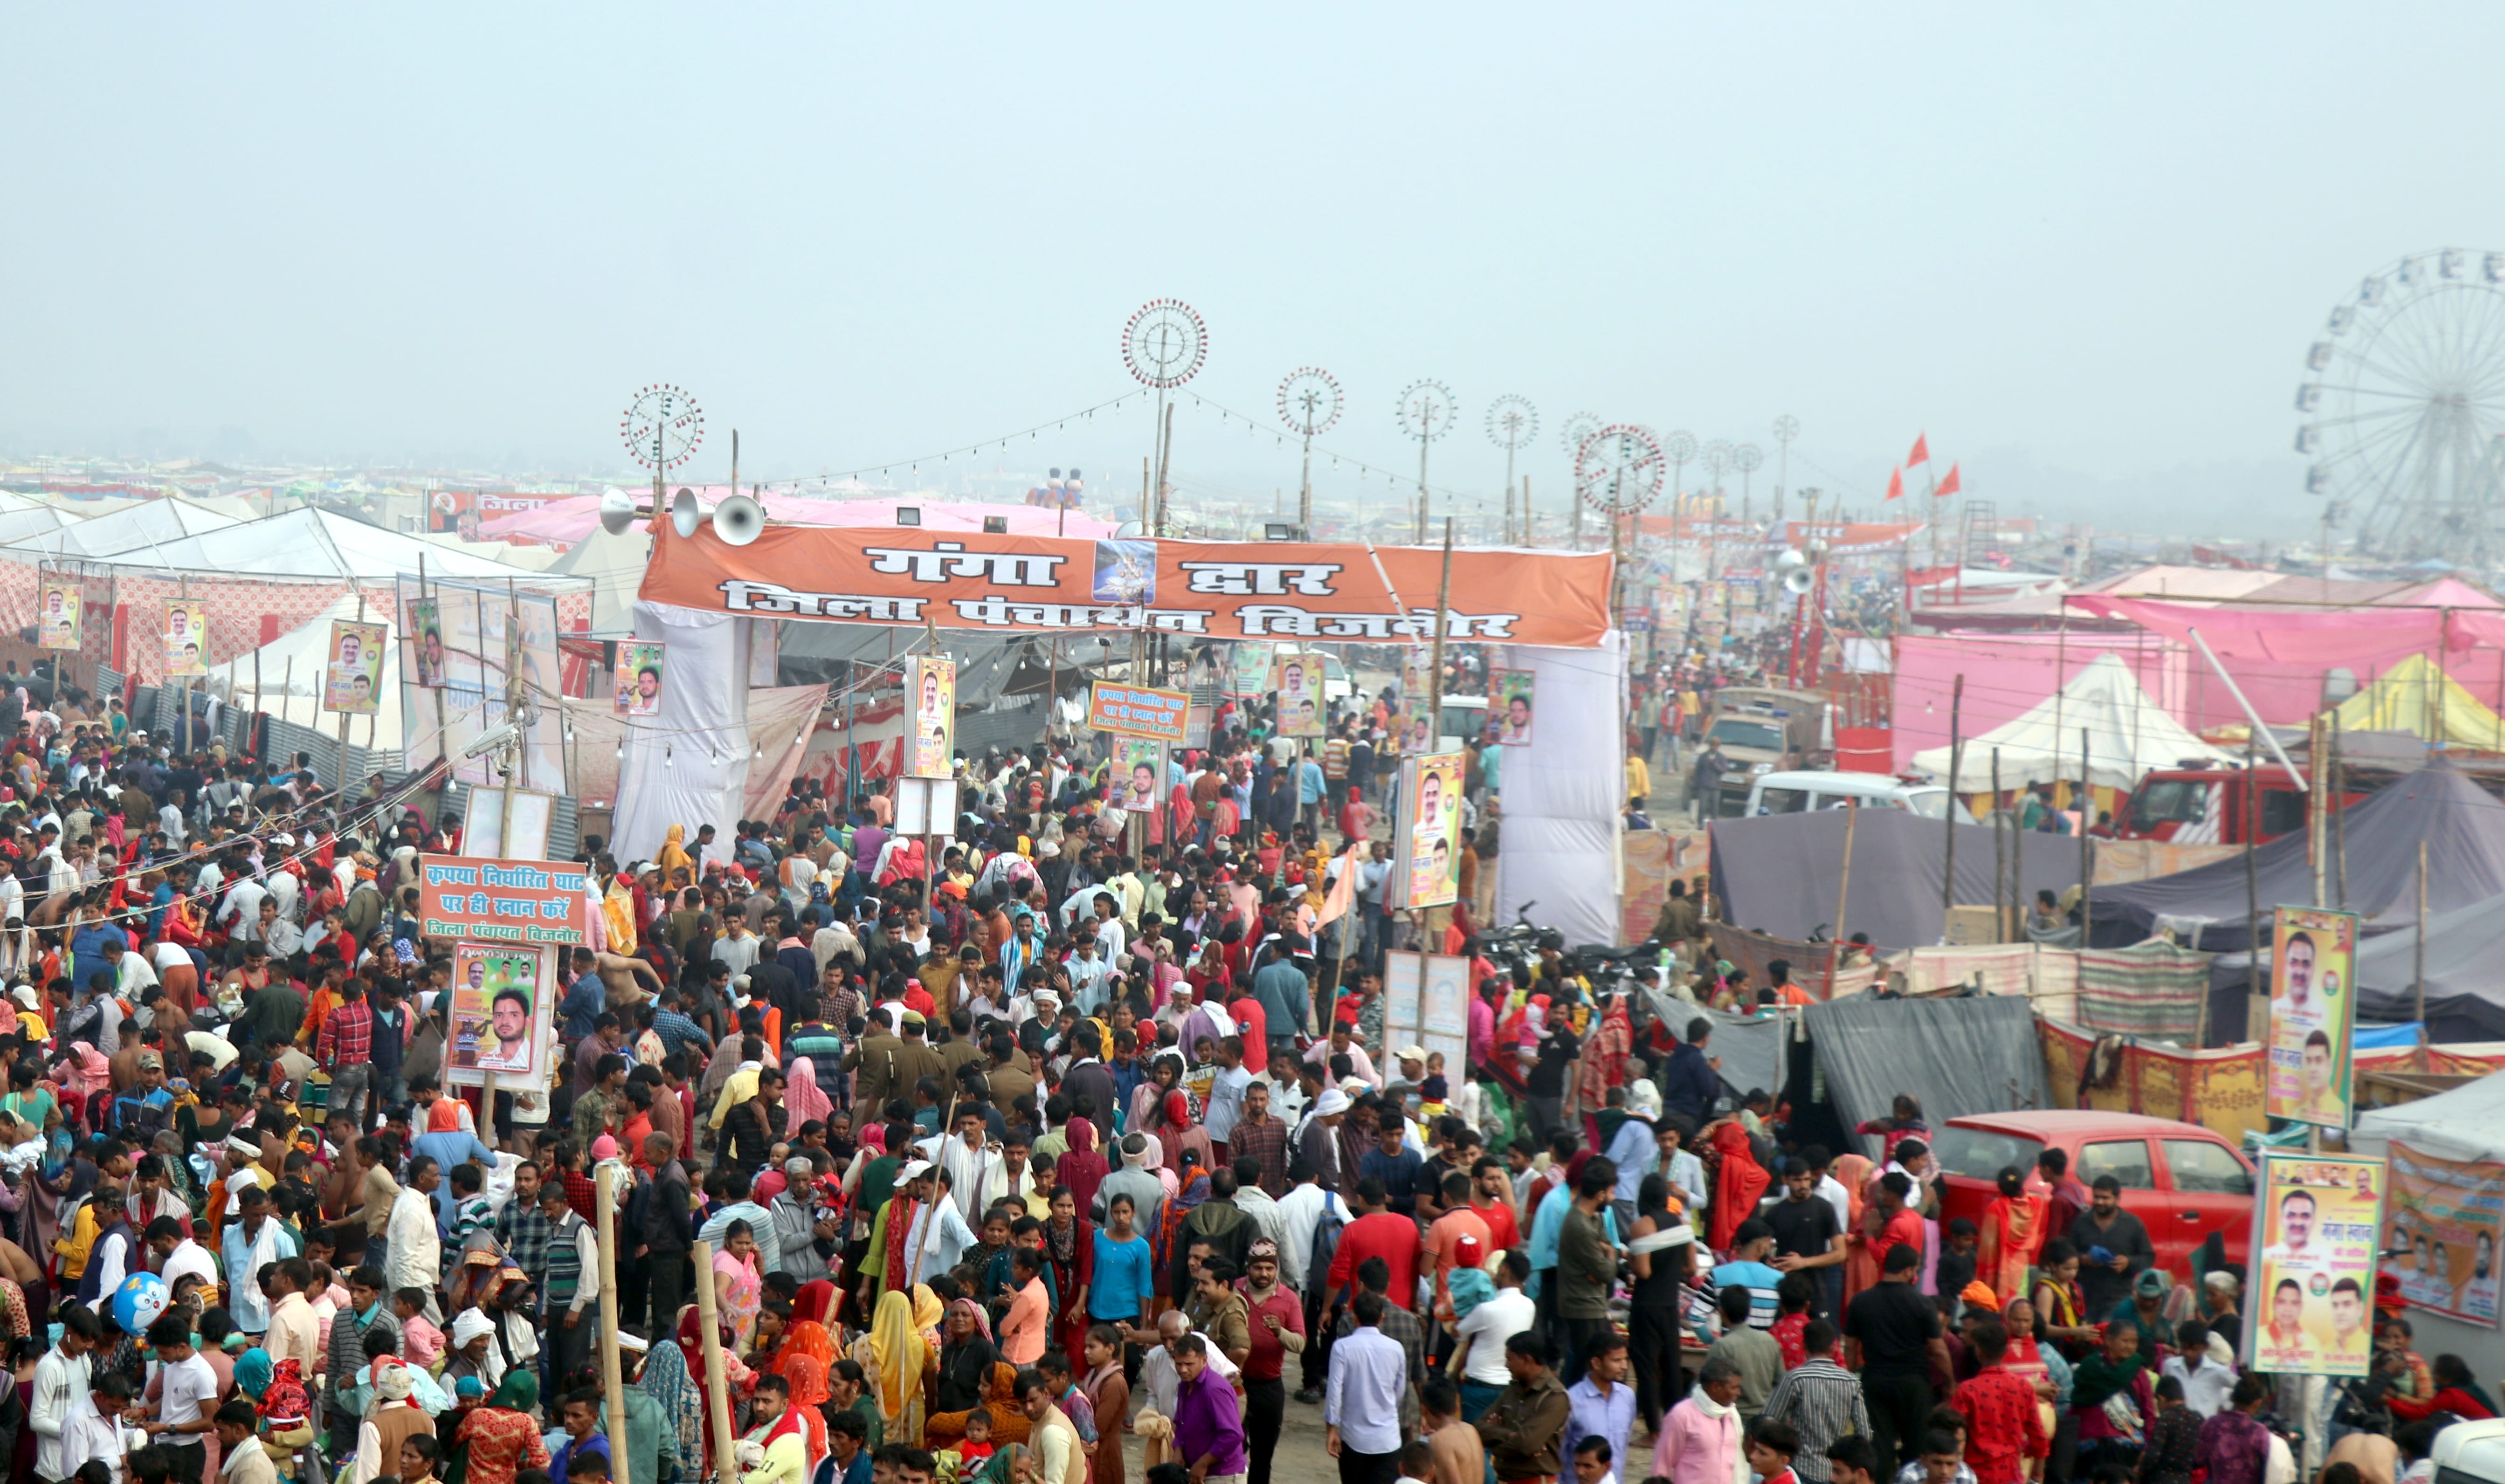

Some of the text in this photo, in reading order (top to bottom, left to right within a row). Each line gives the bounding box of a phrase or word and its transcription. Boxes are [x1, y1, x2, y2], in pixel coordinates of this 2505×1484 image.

[863, 542, 1343, 596] गंगा द्वार
[717, 579, 930, 622] जिला
[949, 596, 1215, 633] पंचायत
[1098, 689, 1125, 701] कृपया
[1166, 699, 1184, 709] घाट
[1094, 715, 1116, 726] जिला
[1120, 719, 1147, 731] पंचायत
[1104, 705, 1117, 715] पर
[1119, 705, 1130, 718] ही
[1133, 709, 1155, 721] स्नान
[426, 864, 585, 891] कृपया निर्धारित घाट
[440, 893, 570, 919] पर ही स्नान करें
[426, 919, 582, 943] जिला पंचायत बिजनौर
